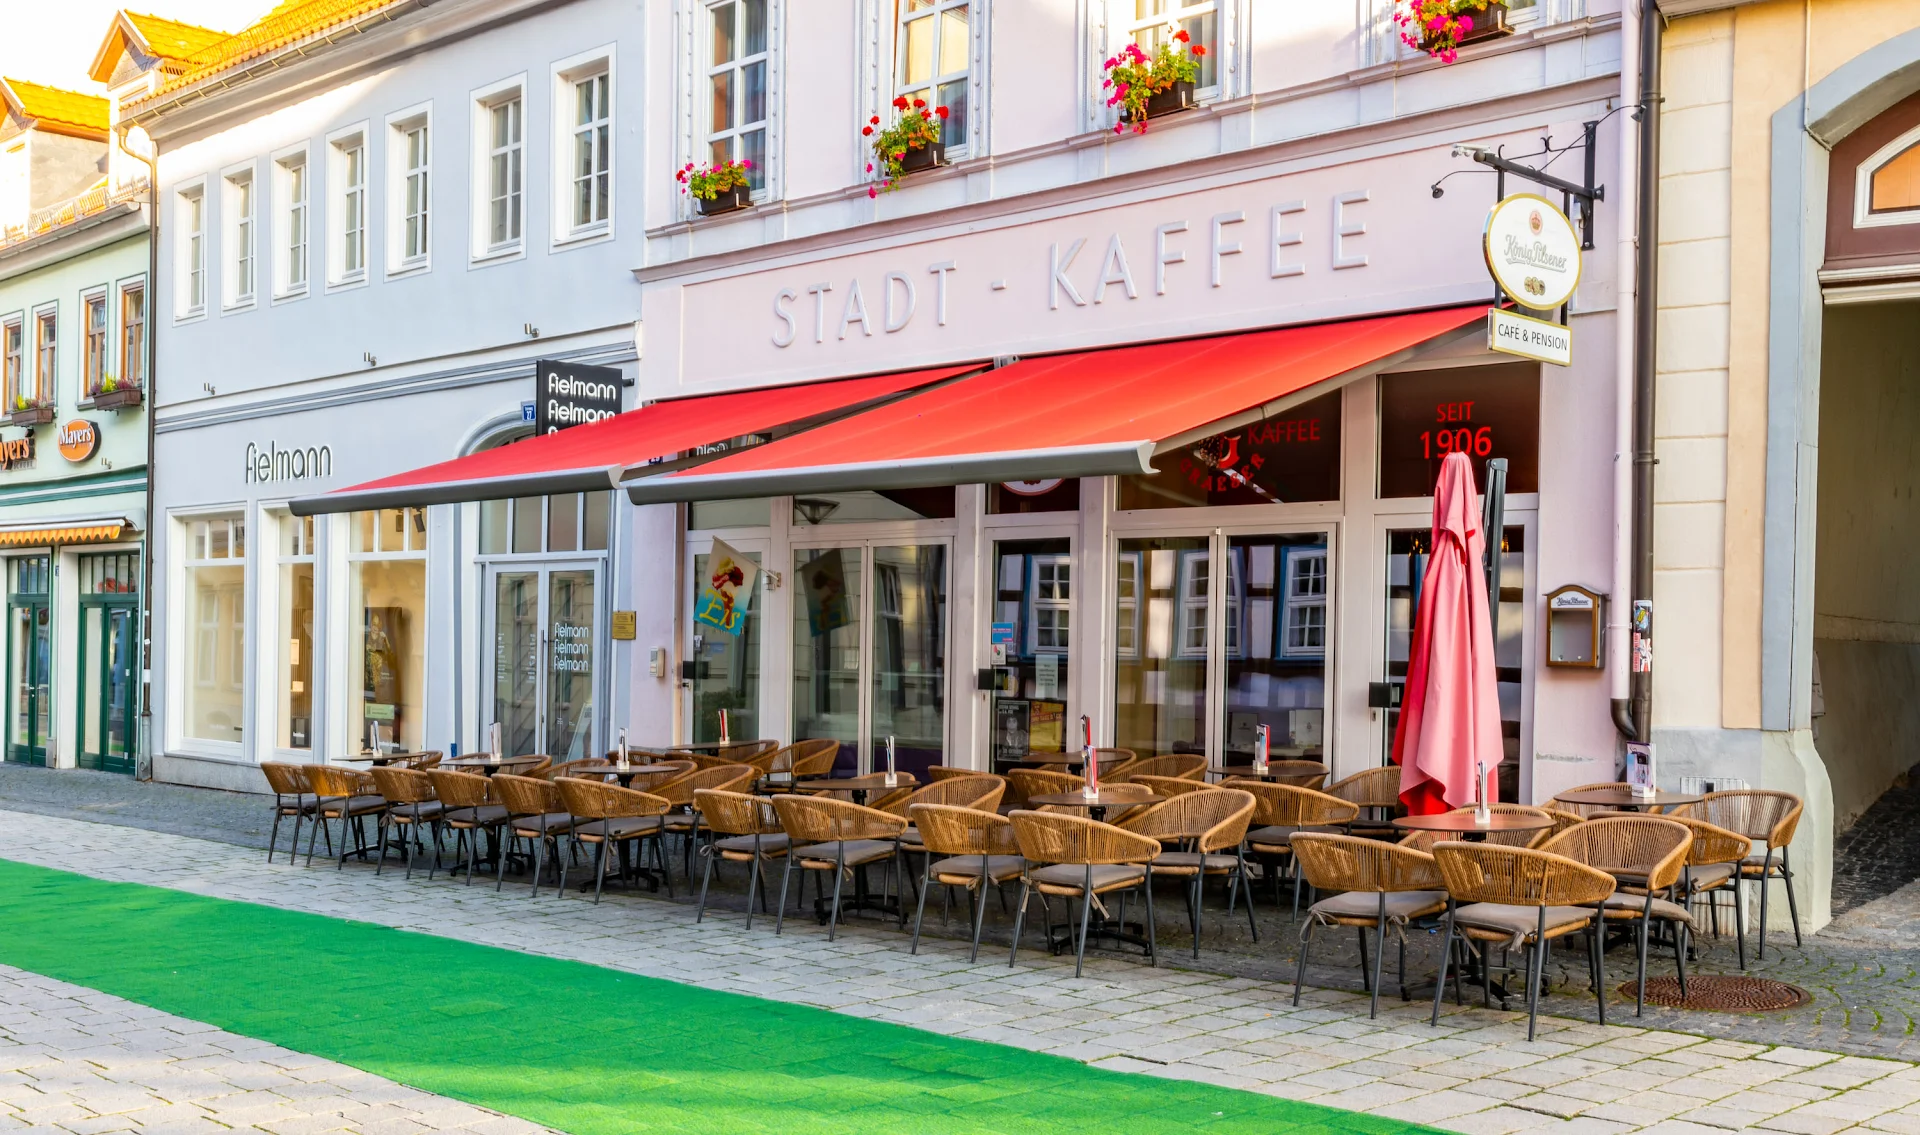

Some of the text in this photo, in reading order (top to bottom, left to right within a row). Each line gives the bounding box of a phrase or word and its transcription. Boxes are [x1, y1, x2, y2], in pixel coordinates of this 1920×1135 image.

[772, 260, 958, 349] STADT
[1048, 189, 1371, 311] KAFFEE
[1504, 234, 1567, 271] König Pilsener
[1498, 322, 1568, 351] CAFÉ & PENSION
[1436, 401, 1475, 422] SEIT
[1247, 419, 1321, 445] KAFFEE
[1420, 426, 1492, 459] 1906
[699, 587, 741, 630] Eis
